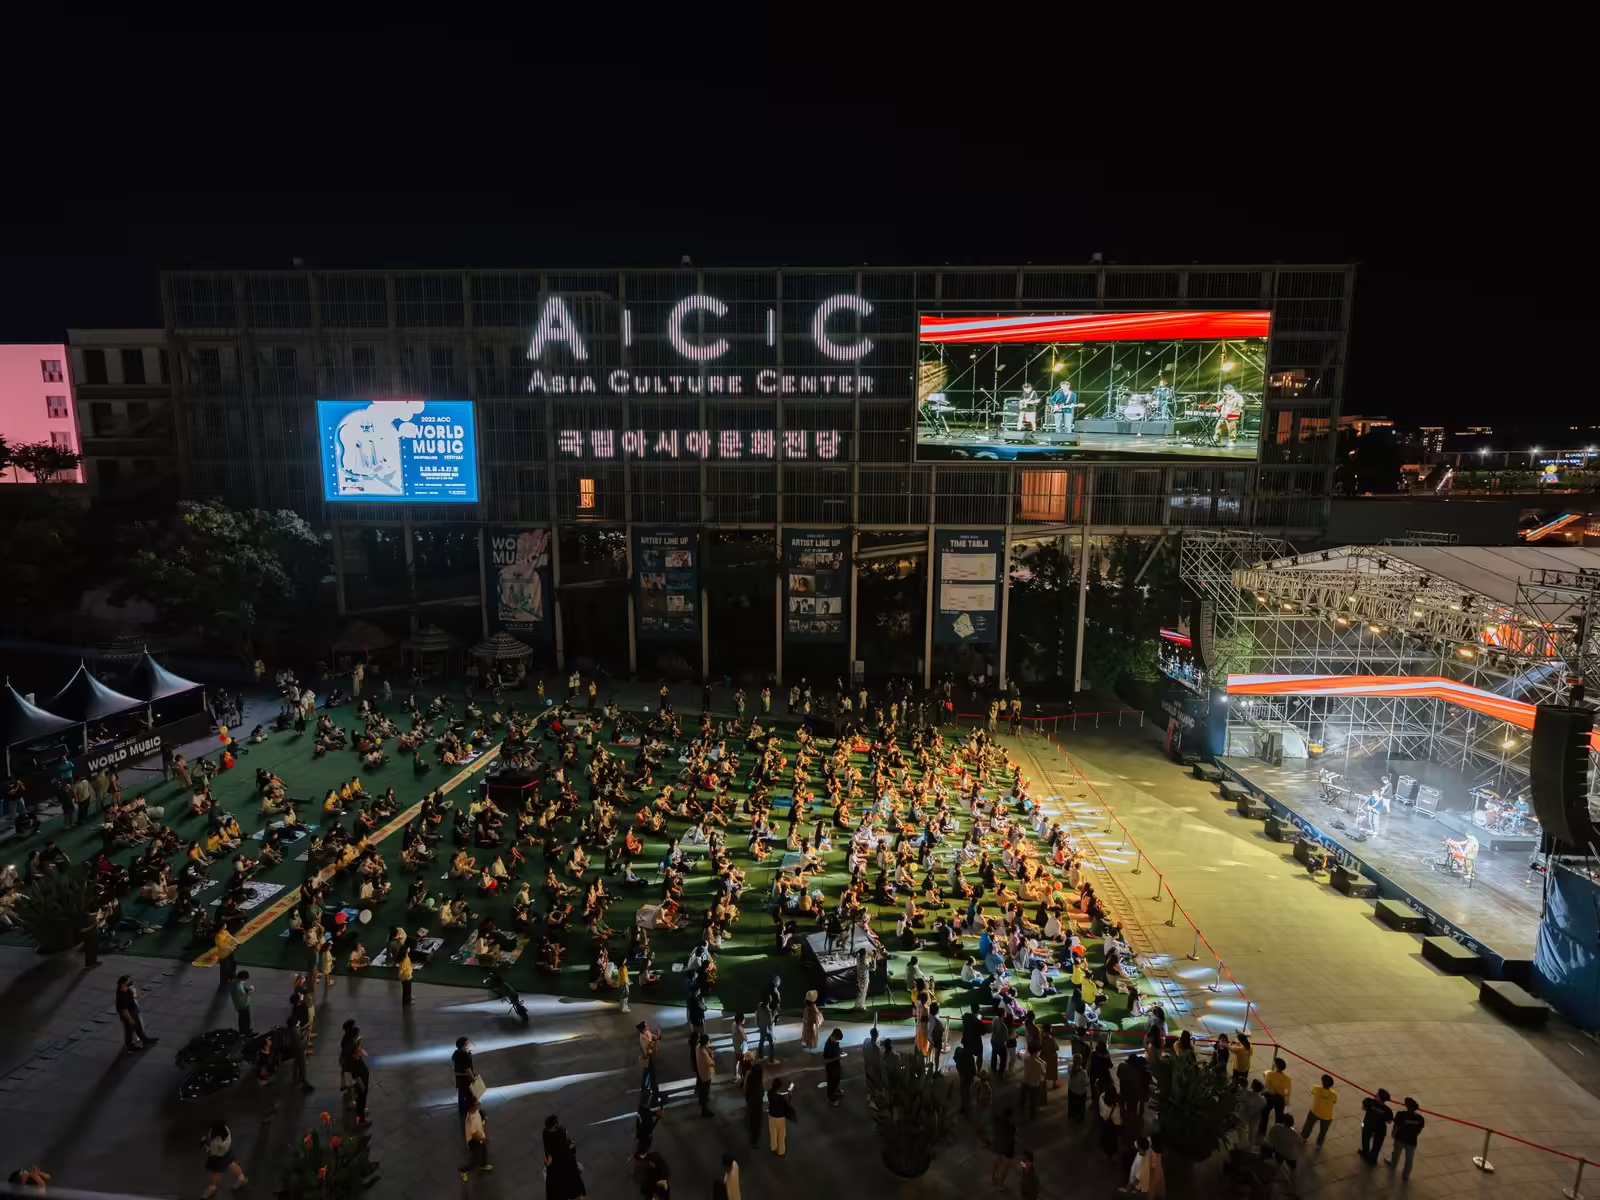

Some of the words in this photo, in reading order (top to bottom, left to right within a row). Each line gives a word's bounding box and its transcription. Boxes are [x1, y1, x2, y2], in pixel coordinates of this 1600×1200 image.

[414, 425, 465, 439] WORLD
[412, 439, 465, 454] MUSIC
[557, 429, 842, 459] 국립아시아문화전당
[640, 536, 662, 545] ARTIST
[679, 536, 689, 545] UP
[791, 538, 814, 547] ARTIST
[815, 538, 830, 547] LINE
[831, 538, 841, 547] UP
[950, 540, 966, 548] TIME
[967, 539, 989, 548] TABLE
[87, 748, 128, 772] WORLD
[129, 735, 161, 756] MUSIC
